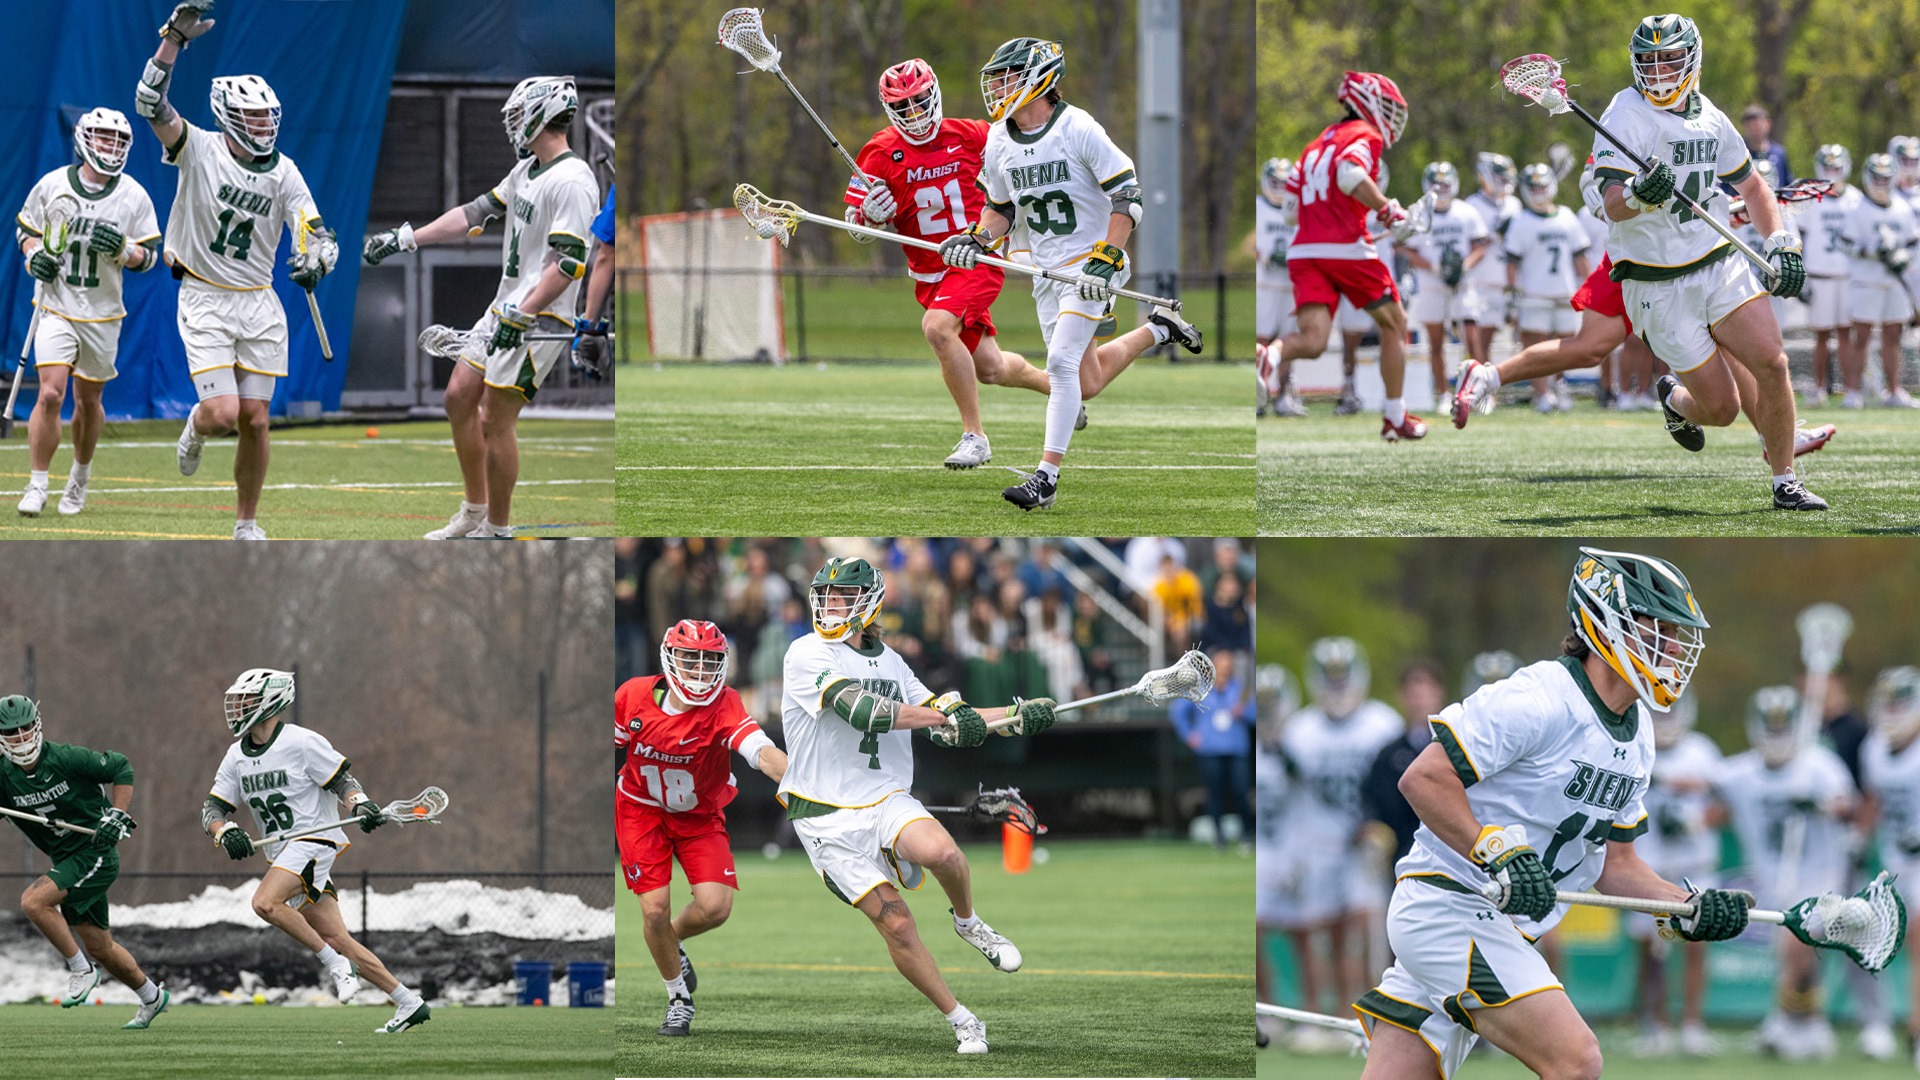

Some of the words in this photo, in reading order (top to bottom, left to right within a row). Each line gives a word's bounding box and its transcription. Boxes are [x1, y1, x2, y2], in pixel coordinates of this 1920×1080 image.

[906, 161, 961, 184] MARIST
[1006, 158, 1071, 191] SIENA
[216, 183, 273, 218] SIENA
[913, 178, 968, 236] 21
[1018, 189, 1077, 236] 33
[209, 208, 255, 262] 14
[66, 240, 100, 288] 11
[629, 720, 641, 729] EC
[633, 742, 694, 765] MARIST
[241, 769, 290, 794] SIENA
[640, 764, 699, 812] 18
[249, 791, 295, 835] 26
